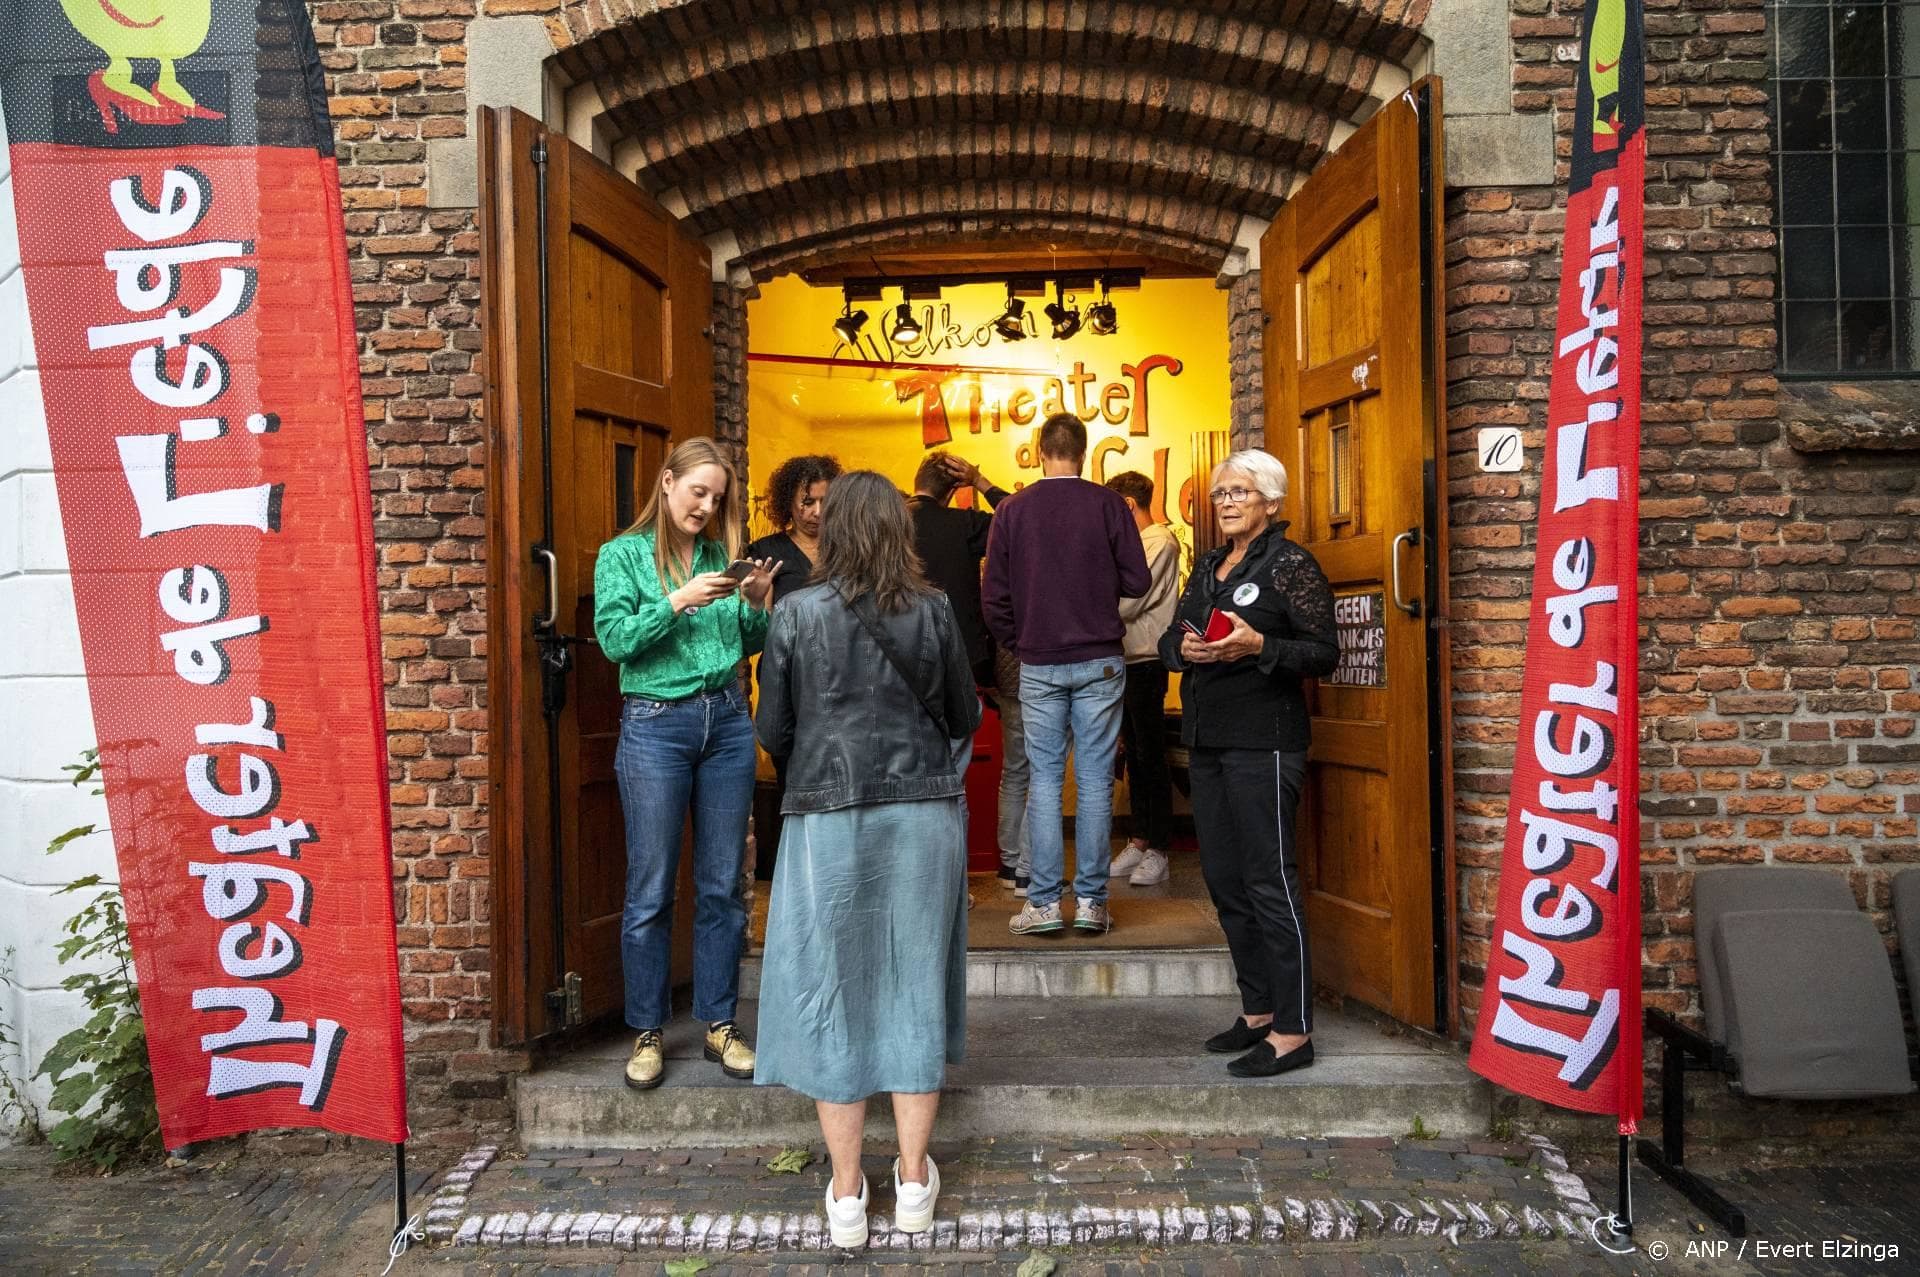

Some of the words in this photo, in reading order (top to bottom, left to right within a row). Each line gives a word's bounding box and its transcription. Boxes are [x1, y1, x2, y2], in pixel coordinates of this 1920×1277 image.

[829, 303, 1040, 362] Welko
[1485, 434, 1517, 466] 10
[1334, 595, 1371, 624] GEEN
